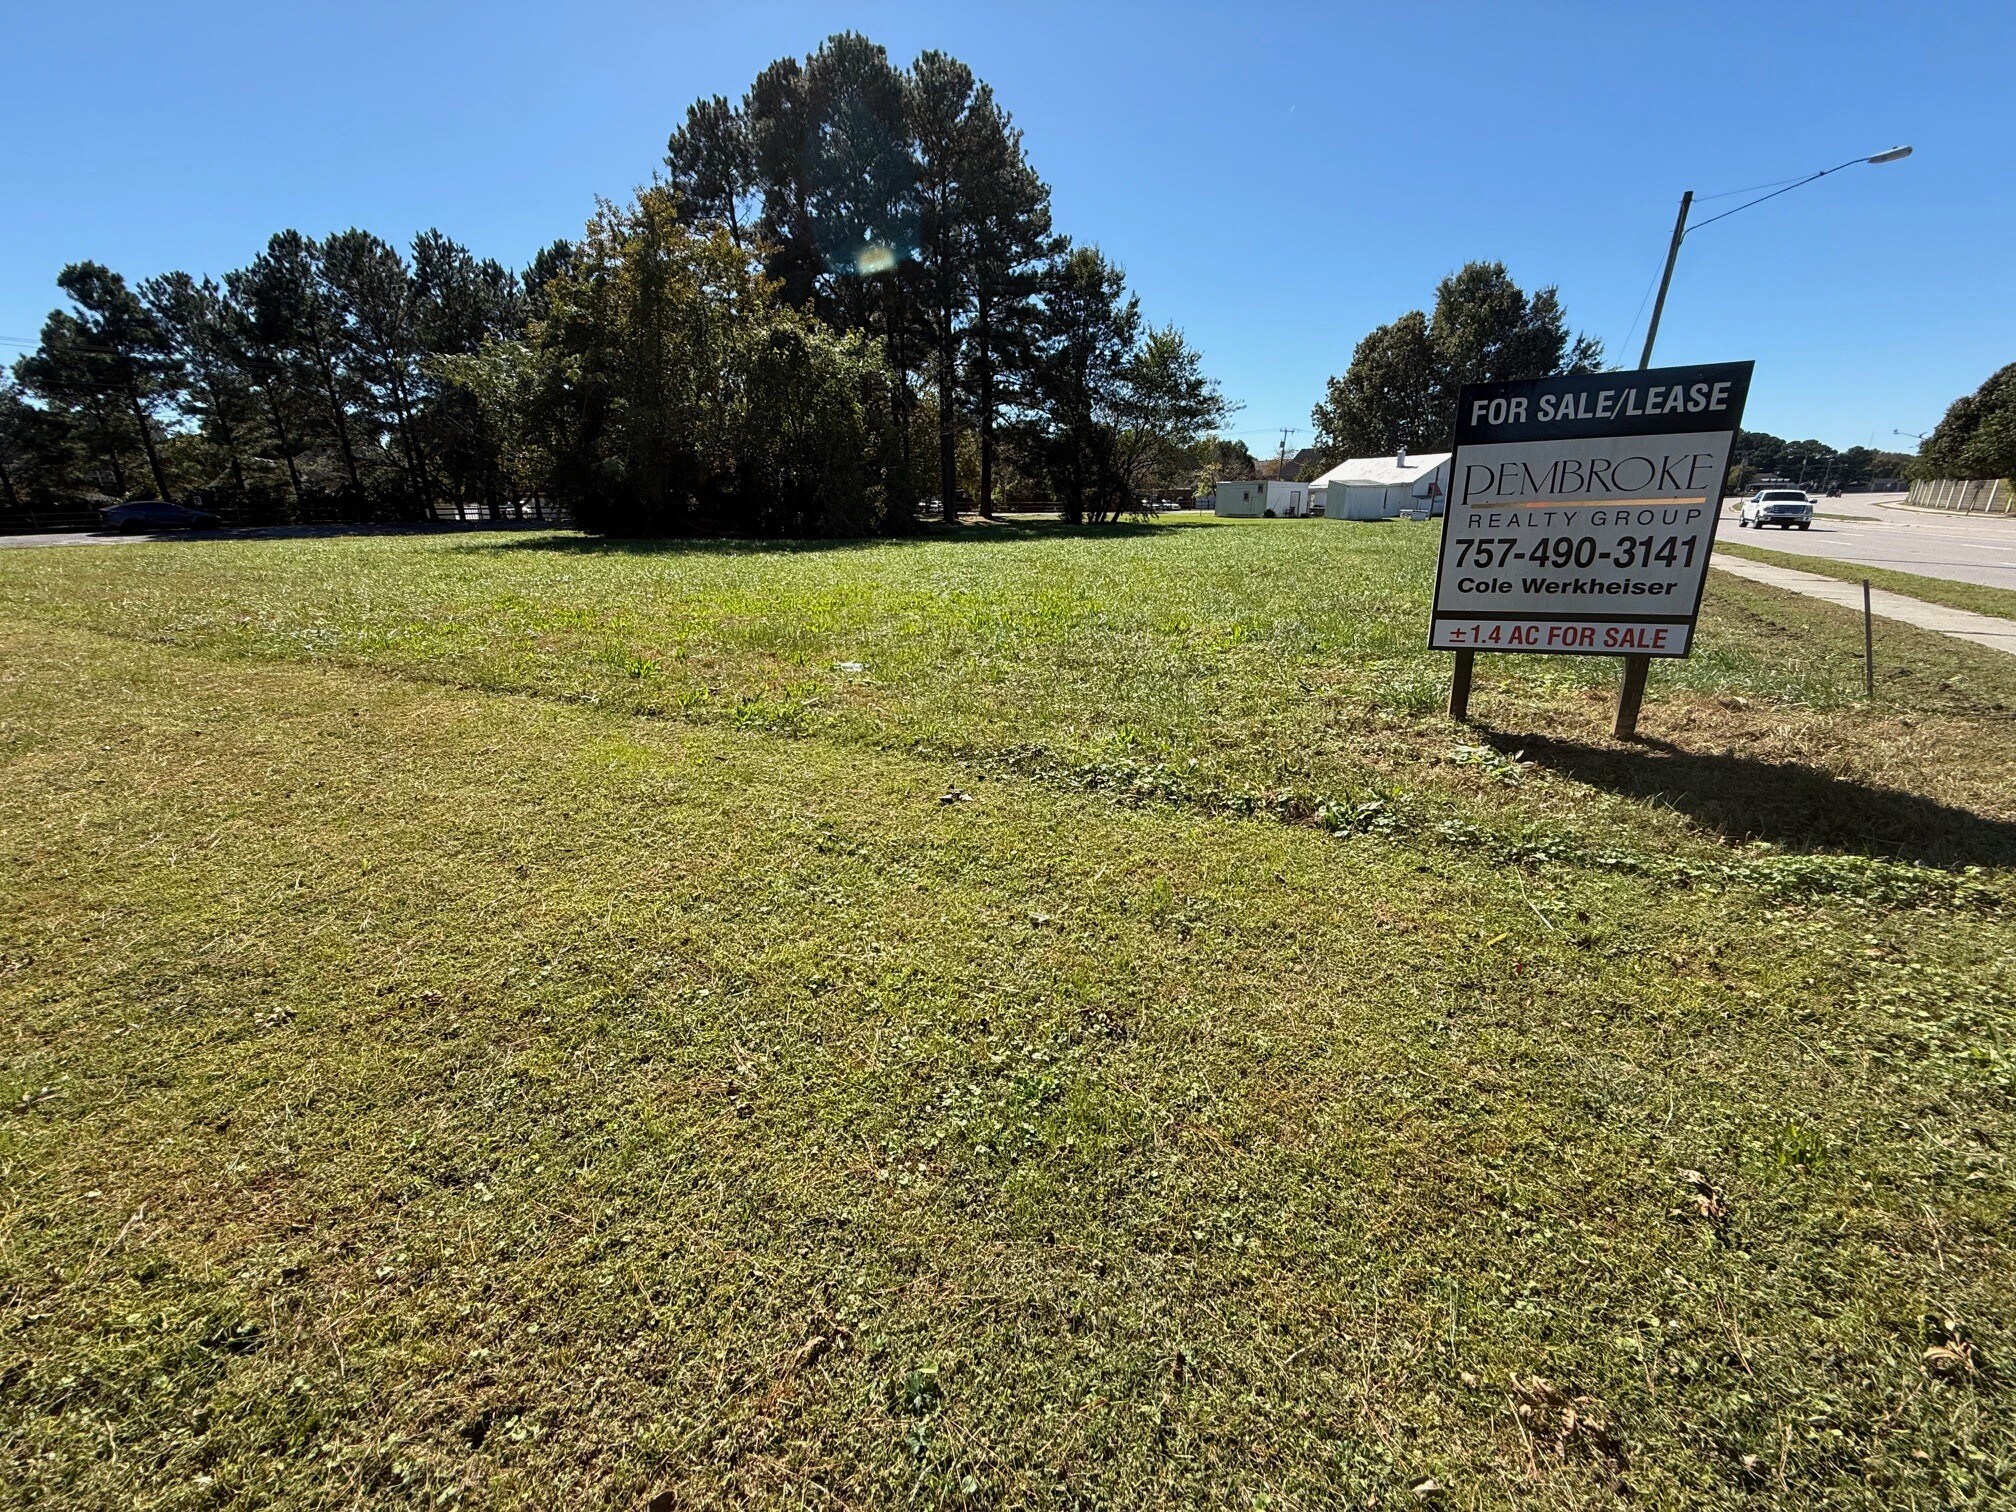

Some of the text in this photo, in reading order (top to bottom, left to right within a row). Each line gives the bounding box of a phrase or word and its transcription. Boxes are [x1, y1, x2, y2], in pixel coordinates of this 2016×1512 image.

[1470, 381, 1732, 426] FOR SALE/LEASE
[1461, 453, 1714, 506] PEMBROKE
[1468, 509, 1702, 528] REALTY GROUP
[1455, 535, 1698, 569] 757-490-3141
[1457, 577, 1678, 595] Cole Werkheiser
[1449, 625, 1669, 649] ±1.4 AC FOR SALE
